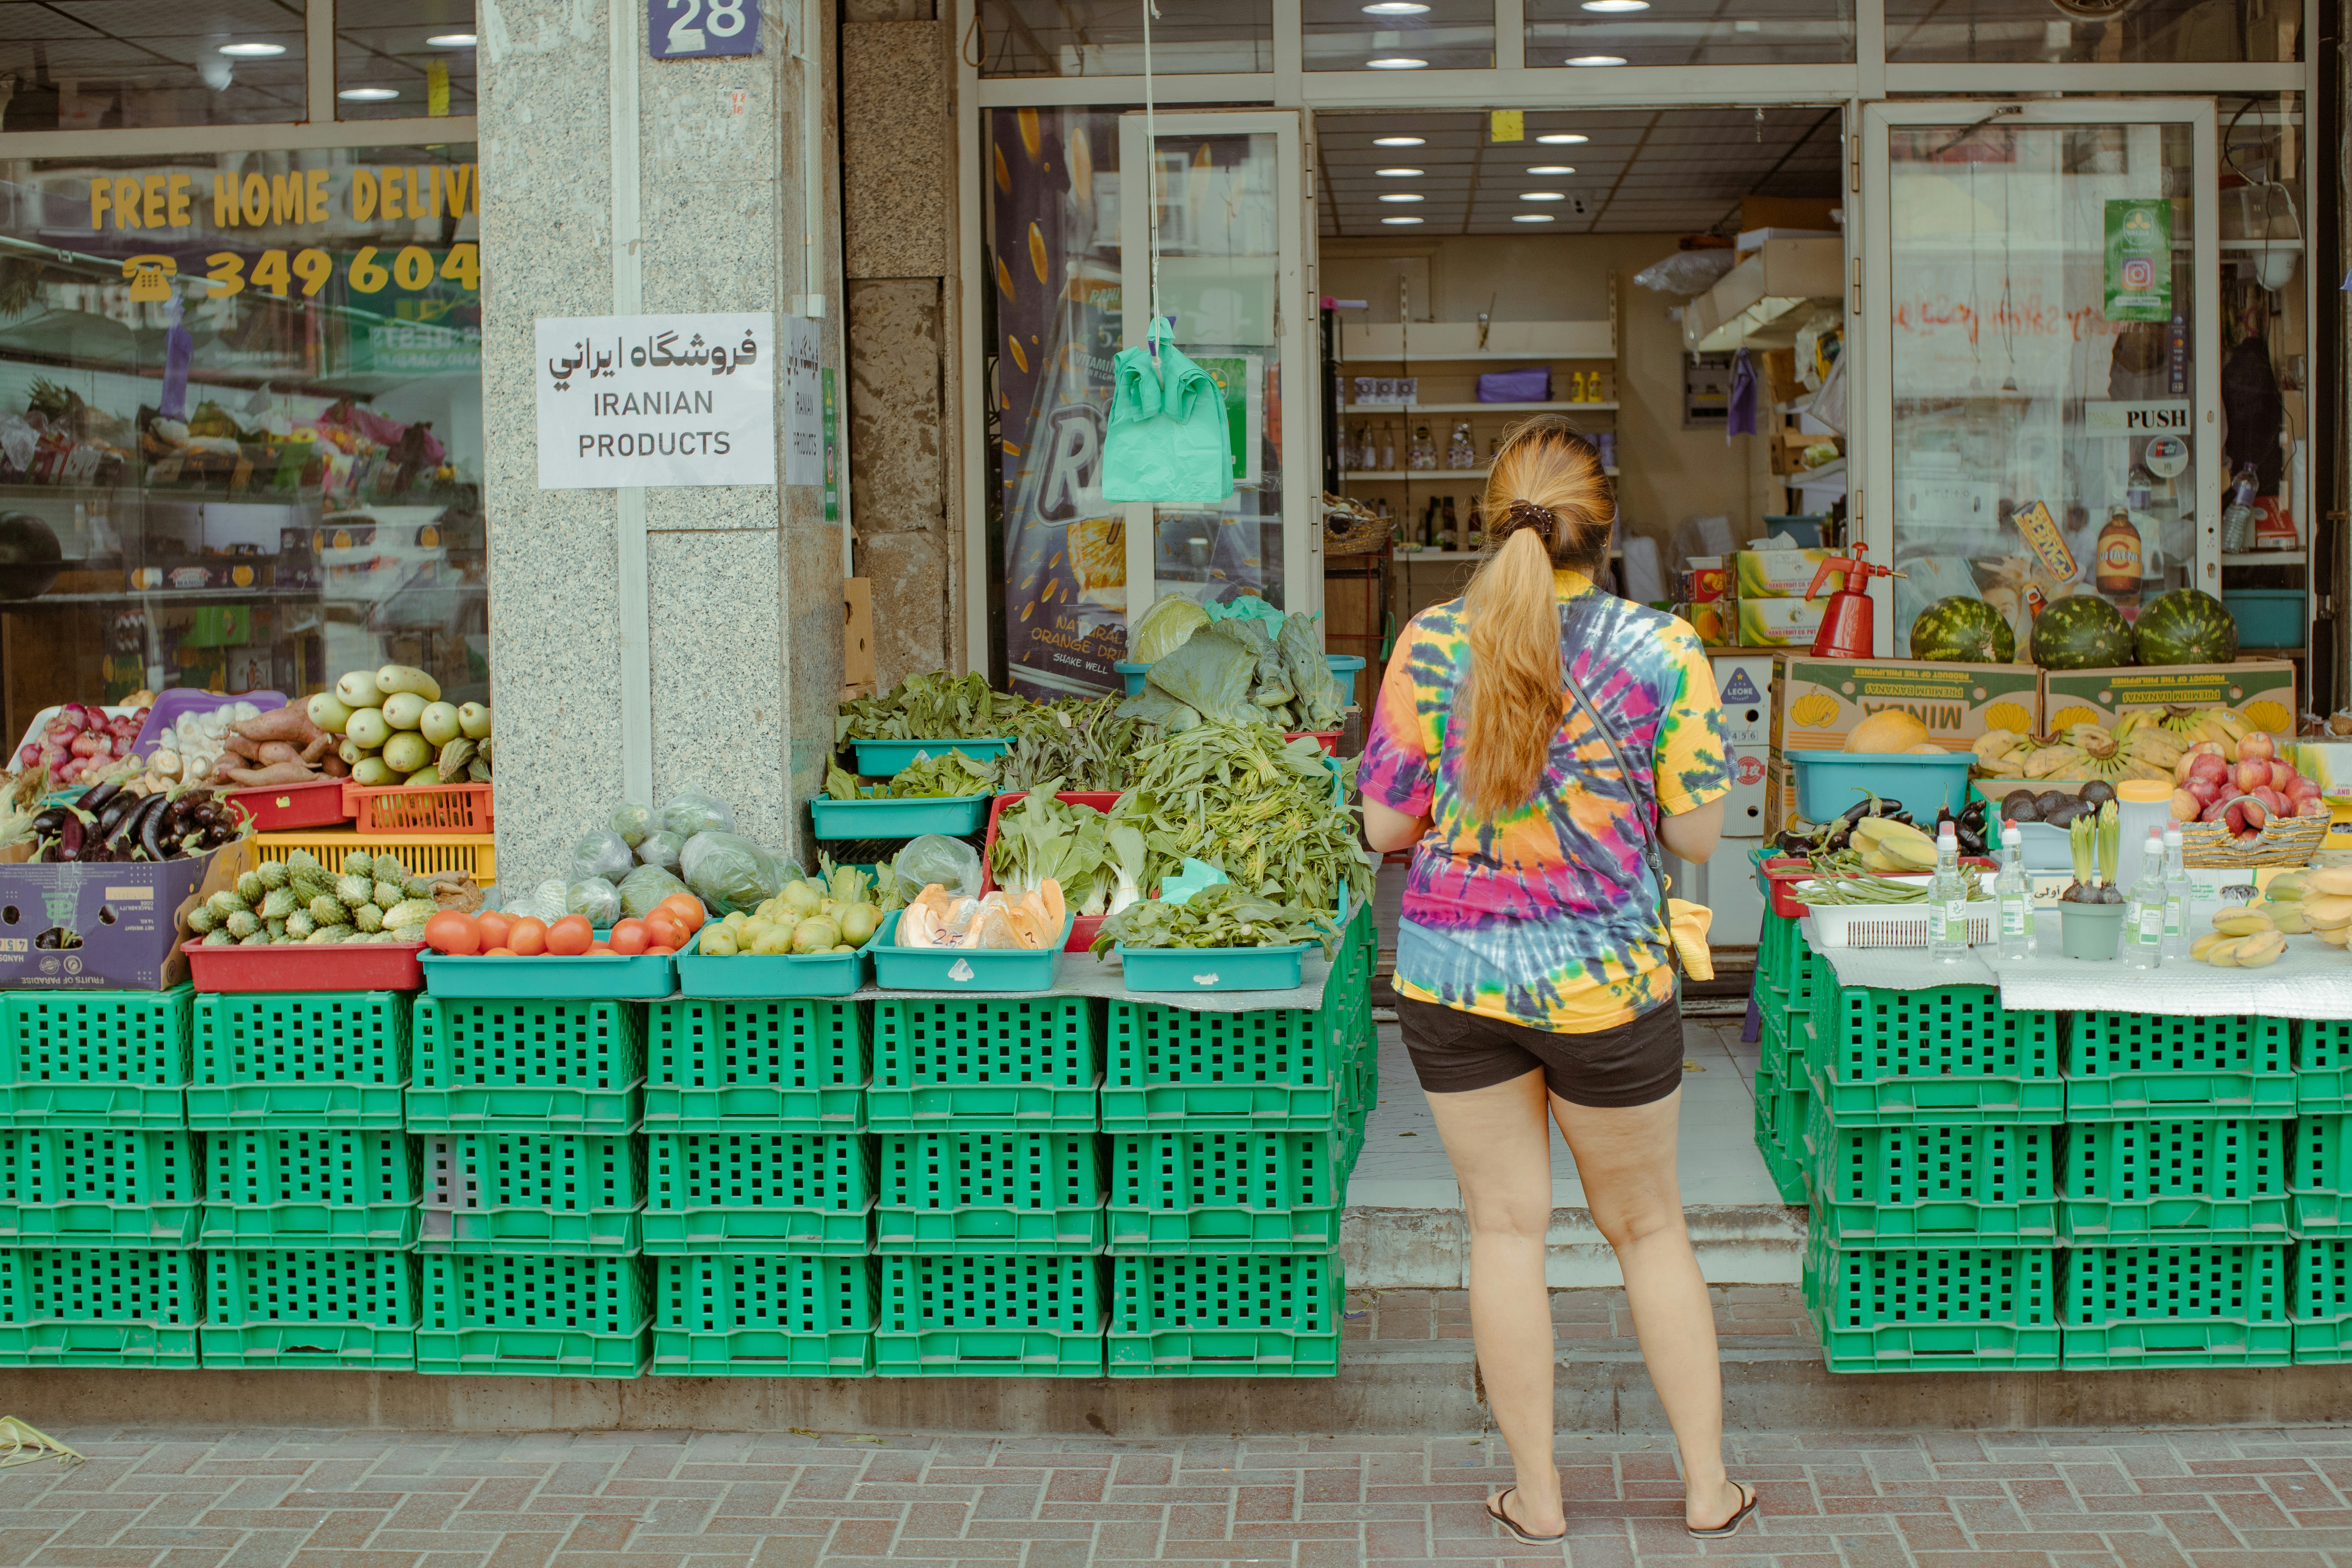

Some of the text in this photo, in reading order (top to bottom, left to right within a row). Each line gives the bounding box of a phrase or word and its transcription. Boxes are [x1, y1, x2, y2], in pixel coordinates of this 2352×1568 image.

[666, 0, 746, 37] 28
[91, 174, 192, 230] FREE
[214, 169, 330, 228] HOME
[205, 248, 333, 299] 349
[594, 390, 713, 417] IRANIAN
[795, 392, 813, 416] IRANIAN
[2126, 409, 2187, 428] PUSH
[580, 432, 731, 457] PRODUCTS
[793, 432, 817, 456] PRODUCTS
[1031, 627, 1092, 653] ORANGE
[1053, 653, 1108, 675] SHAKE WELL
[1854, 668, 1903, 677] PHILIPPINES
[2111, 677, 2159, 685] PHILIPPINES
[2160, 676, 2175, 684] THE
[2189, 674, 2225, 683] PRODUCT
[1727, 687, 1753, 696] LEONE
[1864, 683, 1964, 699] PREMIUM BANANAS
[2122, 689, 2221, 703] PREMIUM BANANAS
[1862, 702, 1962, 730] MINA
[7, 940, 25, 950] 4 5
[75, 976, 104, 984] FRUITS
